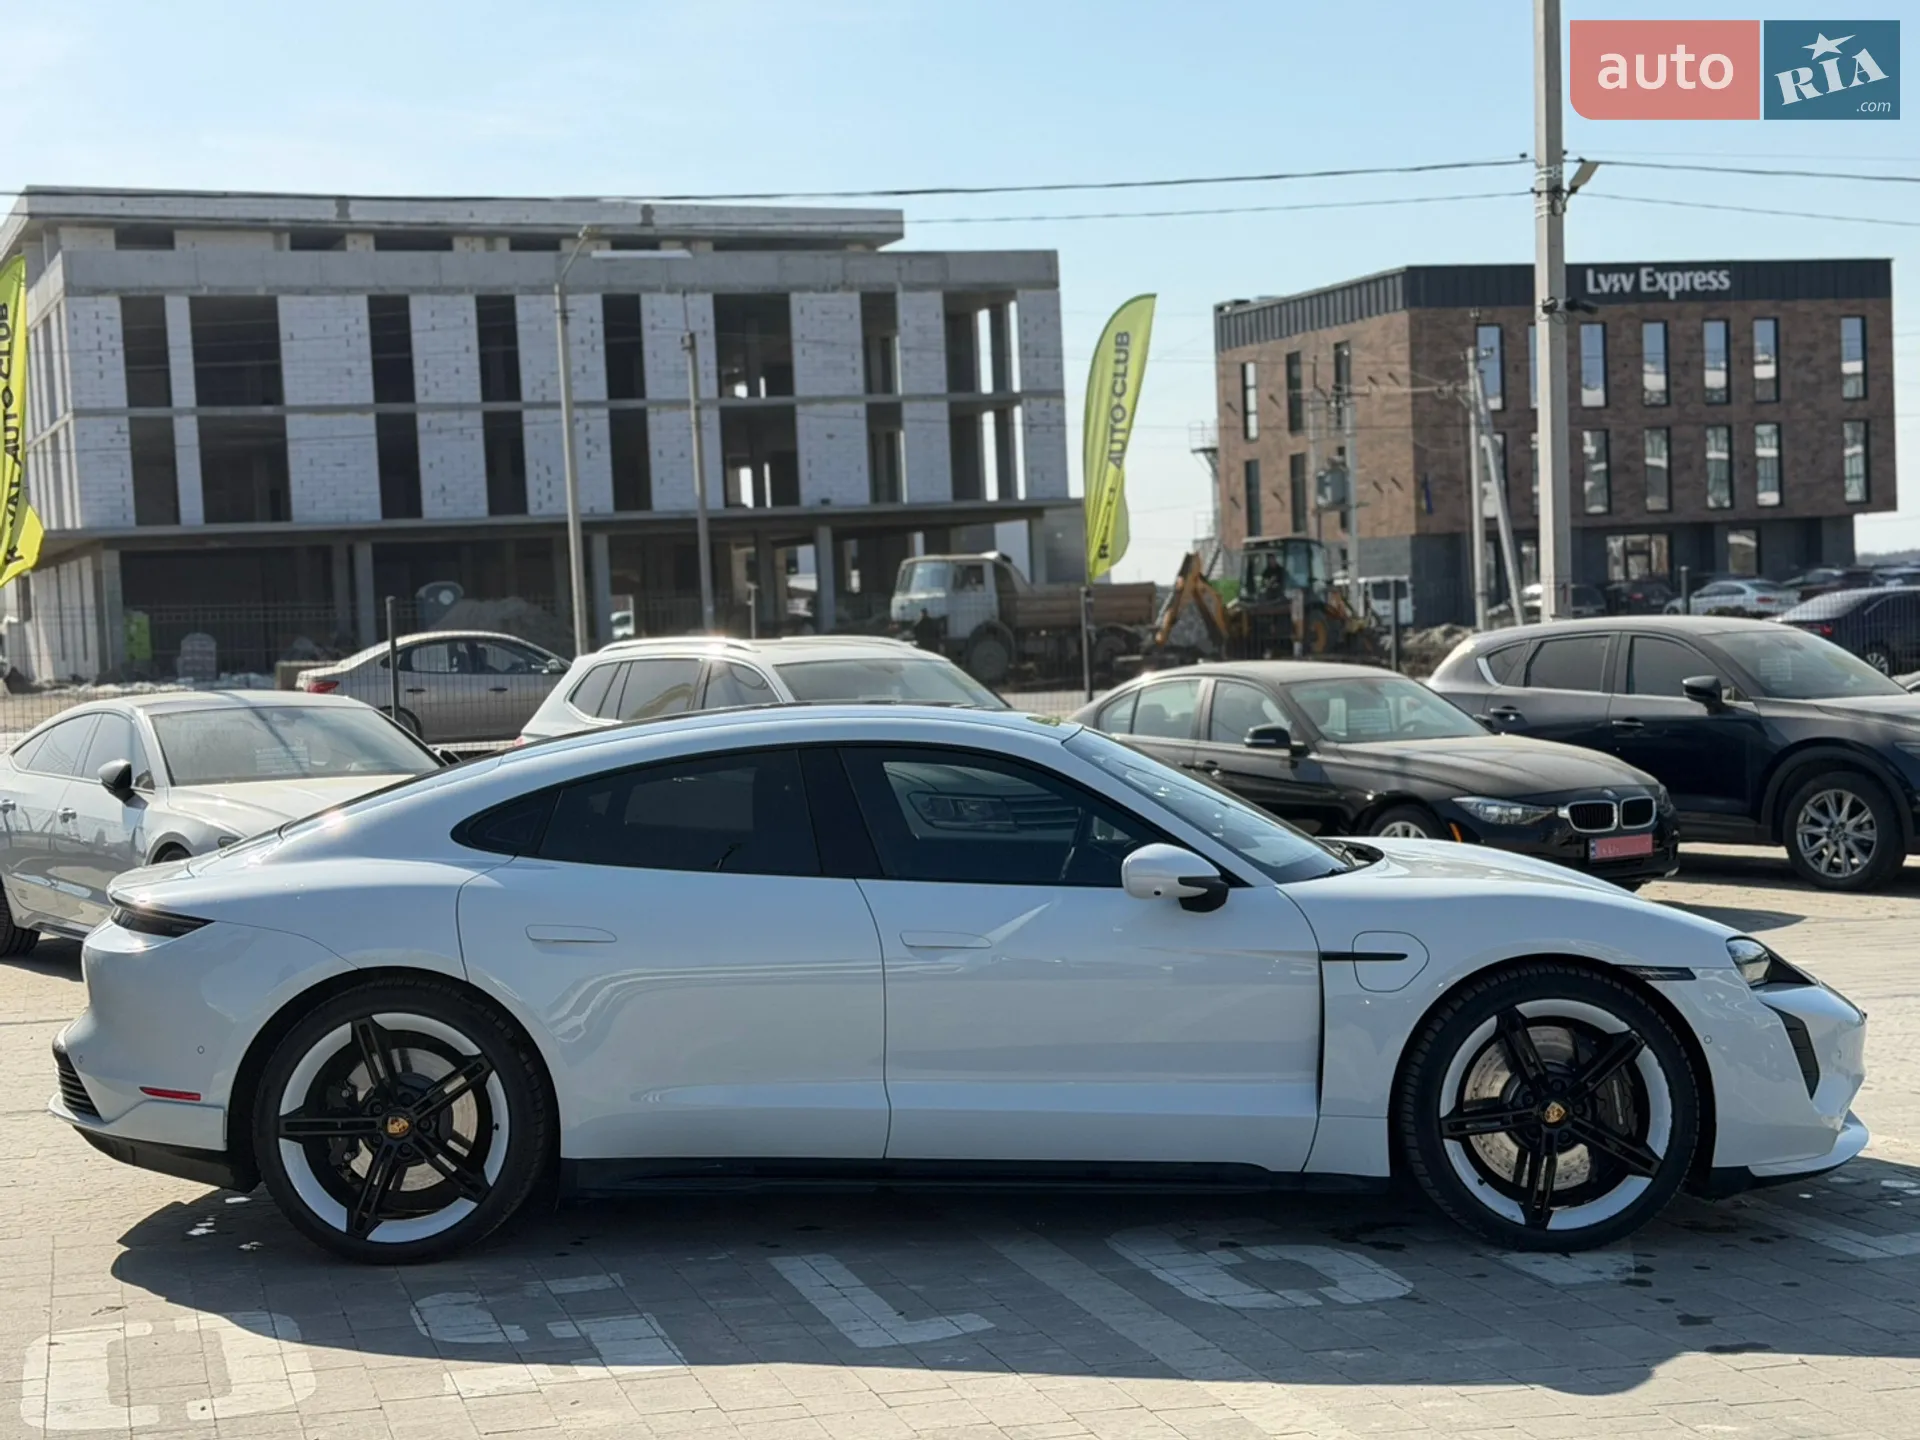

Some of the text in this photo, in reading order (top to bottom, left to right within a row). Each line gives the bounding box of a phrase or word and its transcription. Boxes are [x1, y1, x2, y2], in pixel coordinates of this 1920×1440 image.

[1640, 266, 1731, 300] Express
[1, 385, 22, 467] AUTO
[1108, 331, 1130, 470] AUTO CLUB
